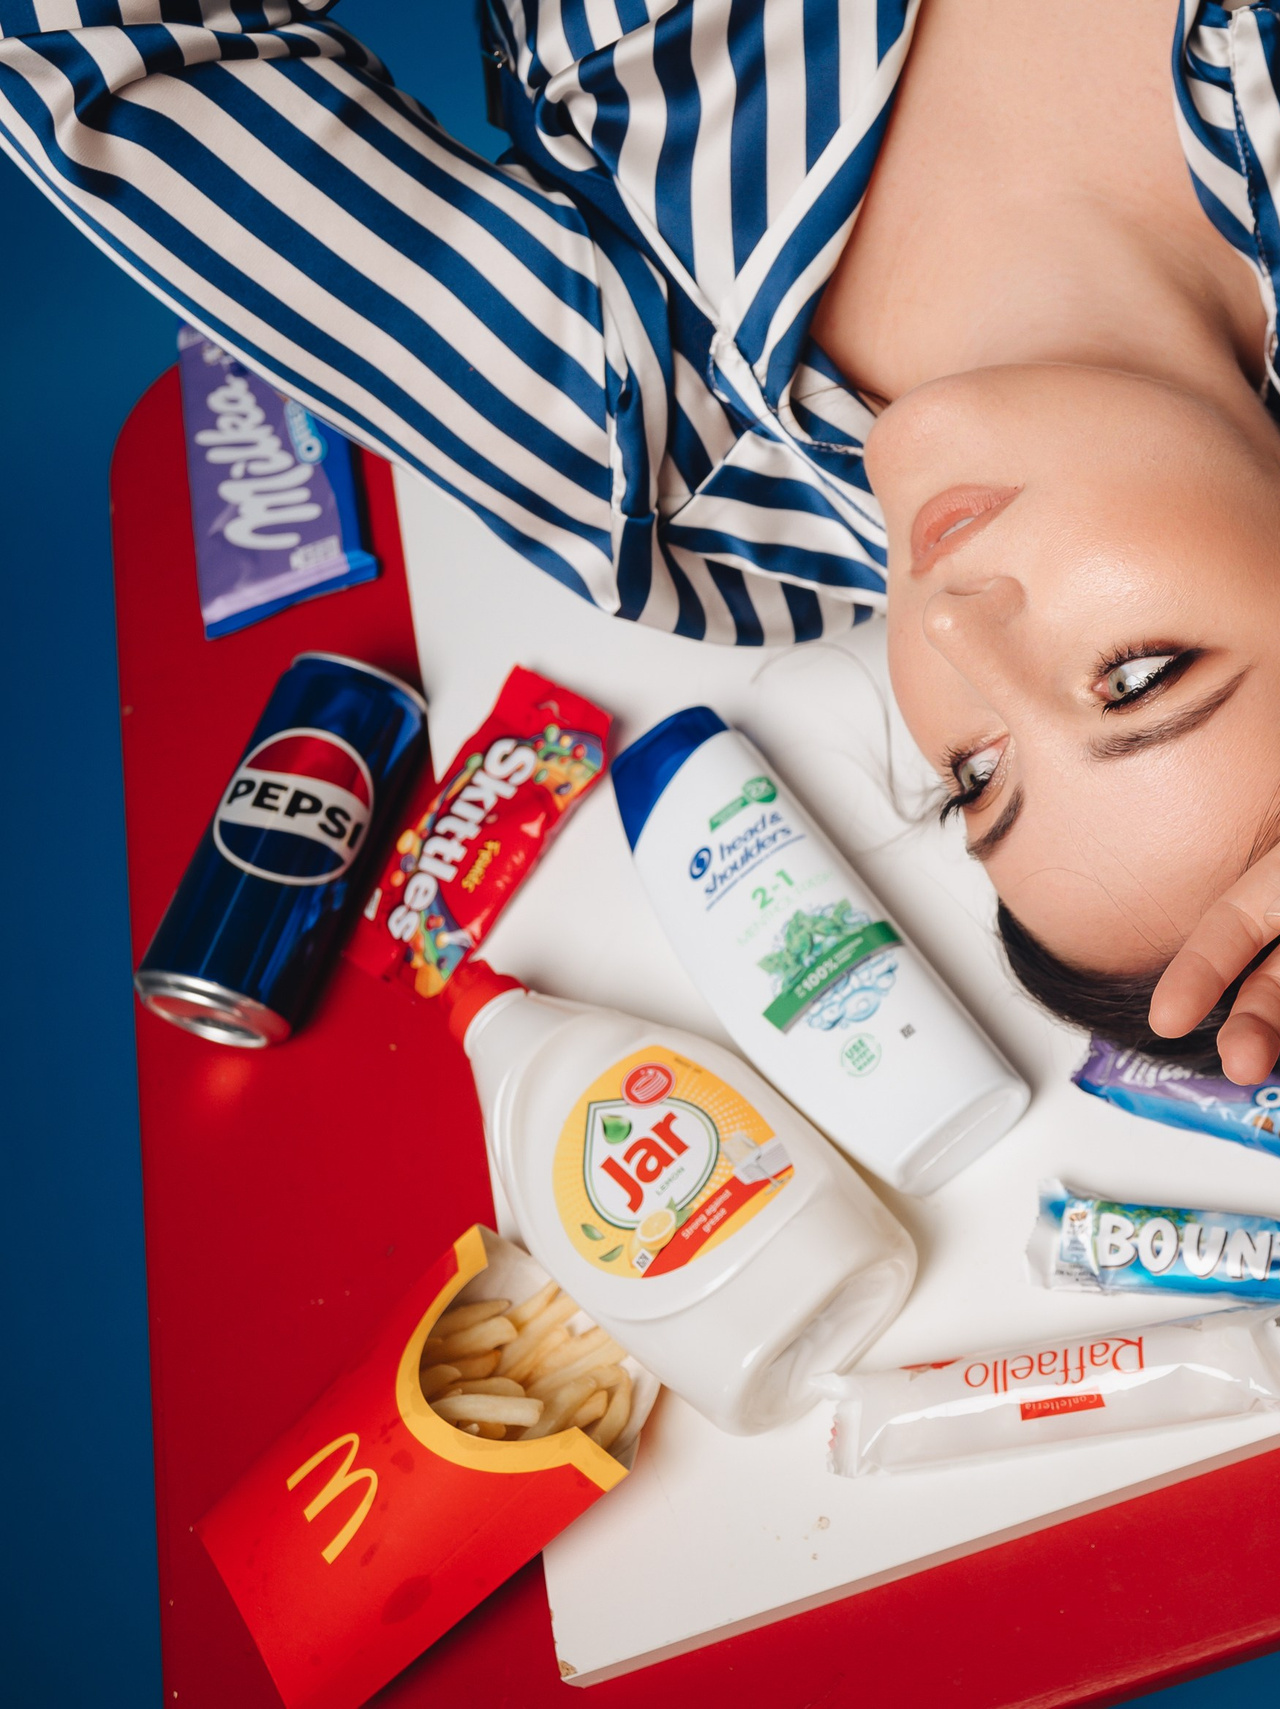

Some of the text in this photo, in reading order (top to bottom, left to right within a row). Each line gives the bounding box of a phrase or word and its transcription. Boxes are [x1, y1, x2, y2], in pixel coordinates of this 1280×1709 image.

[195, 374, 322, 550] Milka
[226, 778, 364, 849] PEPSI
[387, 738, 537, 942] Skittles
[719, 813, 767, 861] head
[769, 811, 783, 825] &
[704, 826, 792, 895] shoulders
[801, 957, 839, 992] 100%
[600, 1112, 689, 1213] Jar
[680, 1188, 733, 1241] Strong against
[700, 1206, 728, 1234] grease
[963, 1336, 1144, 1393] Raffaello
